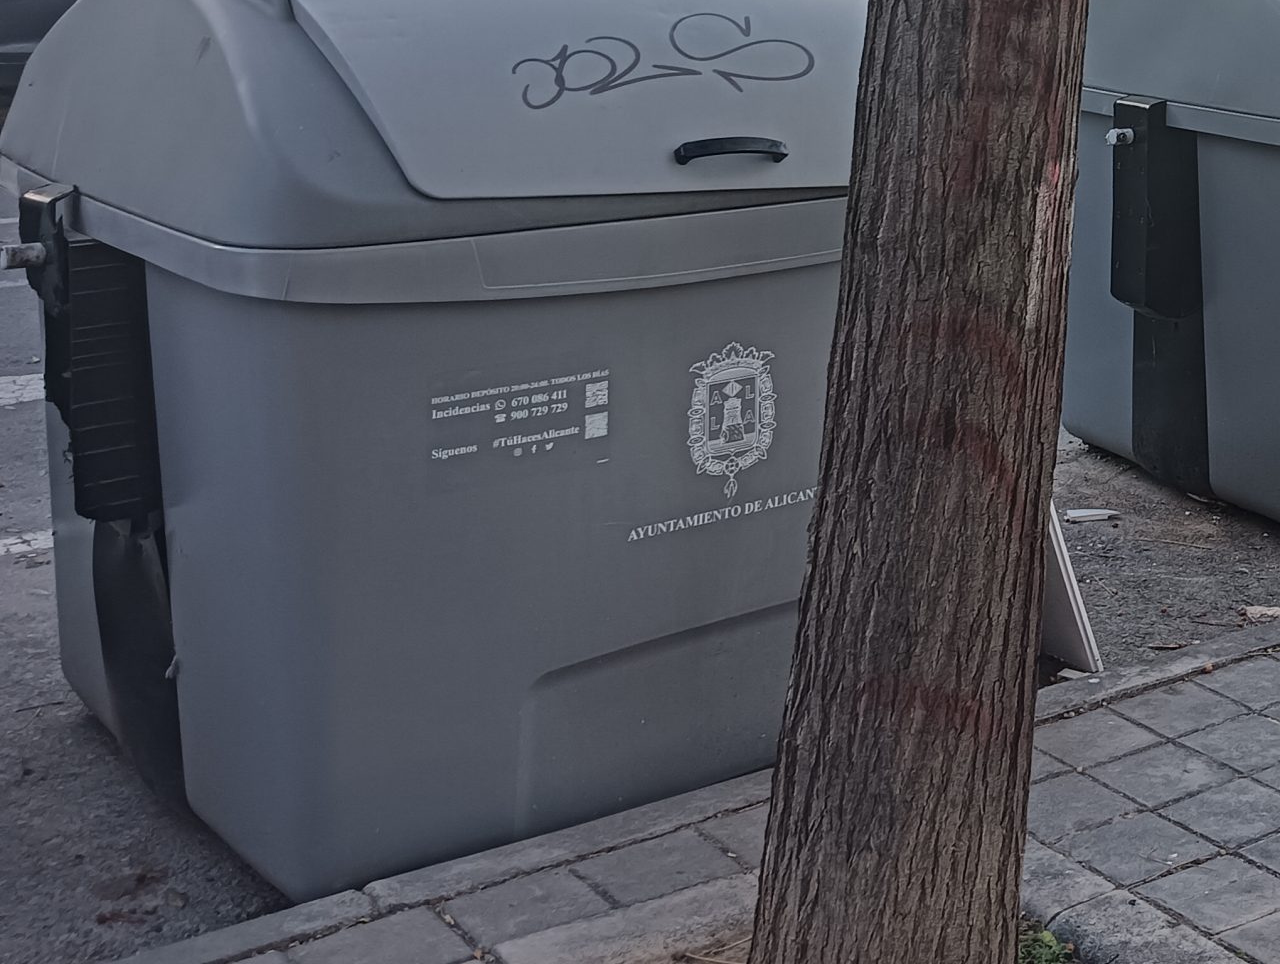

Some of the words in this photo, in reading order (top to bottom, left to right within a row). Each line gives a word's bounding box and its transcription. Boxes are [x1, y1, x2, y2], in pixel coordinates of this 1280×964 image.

[432, 402, 491, 420] Incidencias
[511, 395, 530, 408] 670
[531, 392, 550, 404] 086
[551, 389, 568, 401] 411
[510, 410, 529, 422] 900
[531, 406, 549, 418] 729
[551, 402, 569, 414] 729
[431, 443, 478, 460] Síguenos
[492, 425, 580, 449] #TúHacesAlicante
[627, 505, 742, 542] AYUNTAMIENTO
[744, 500, 763, 515] DE
[764, 486, 819, 511] ALICAN
